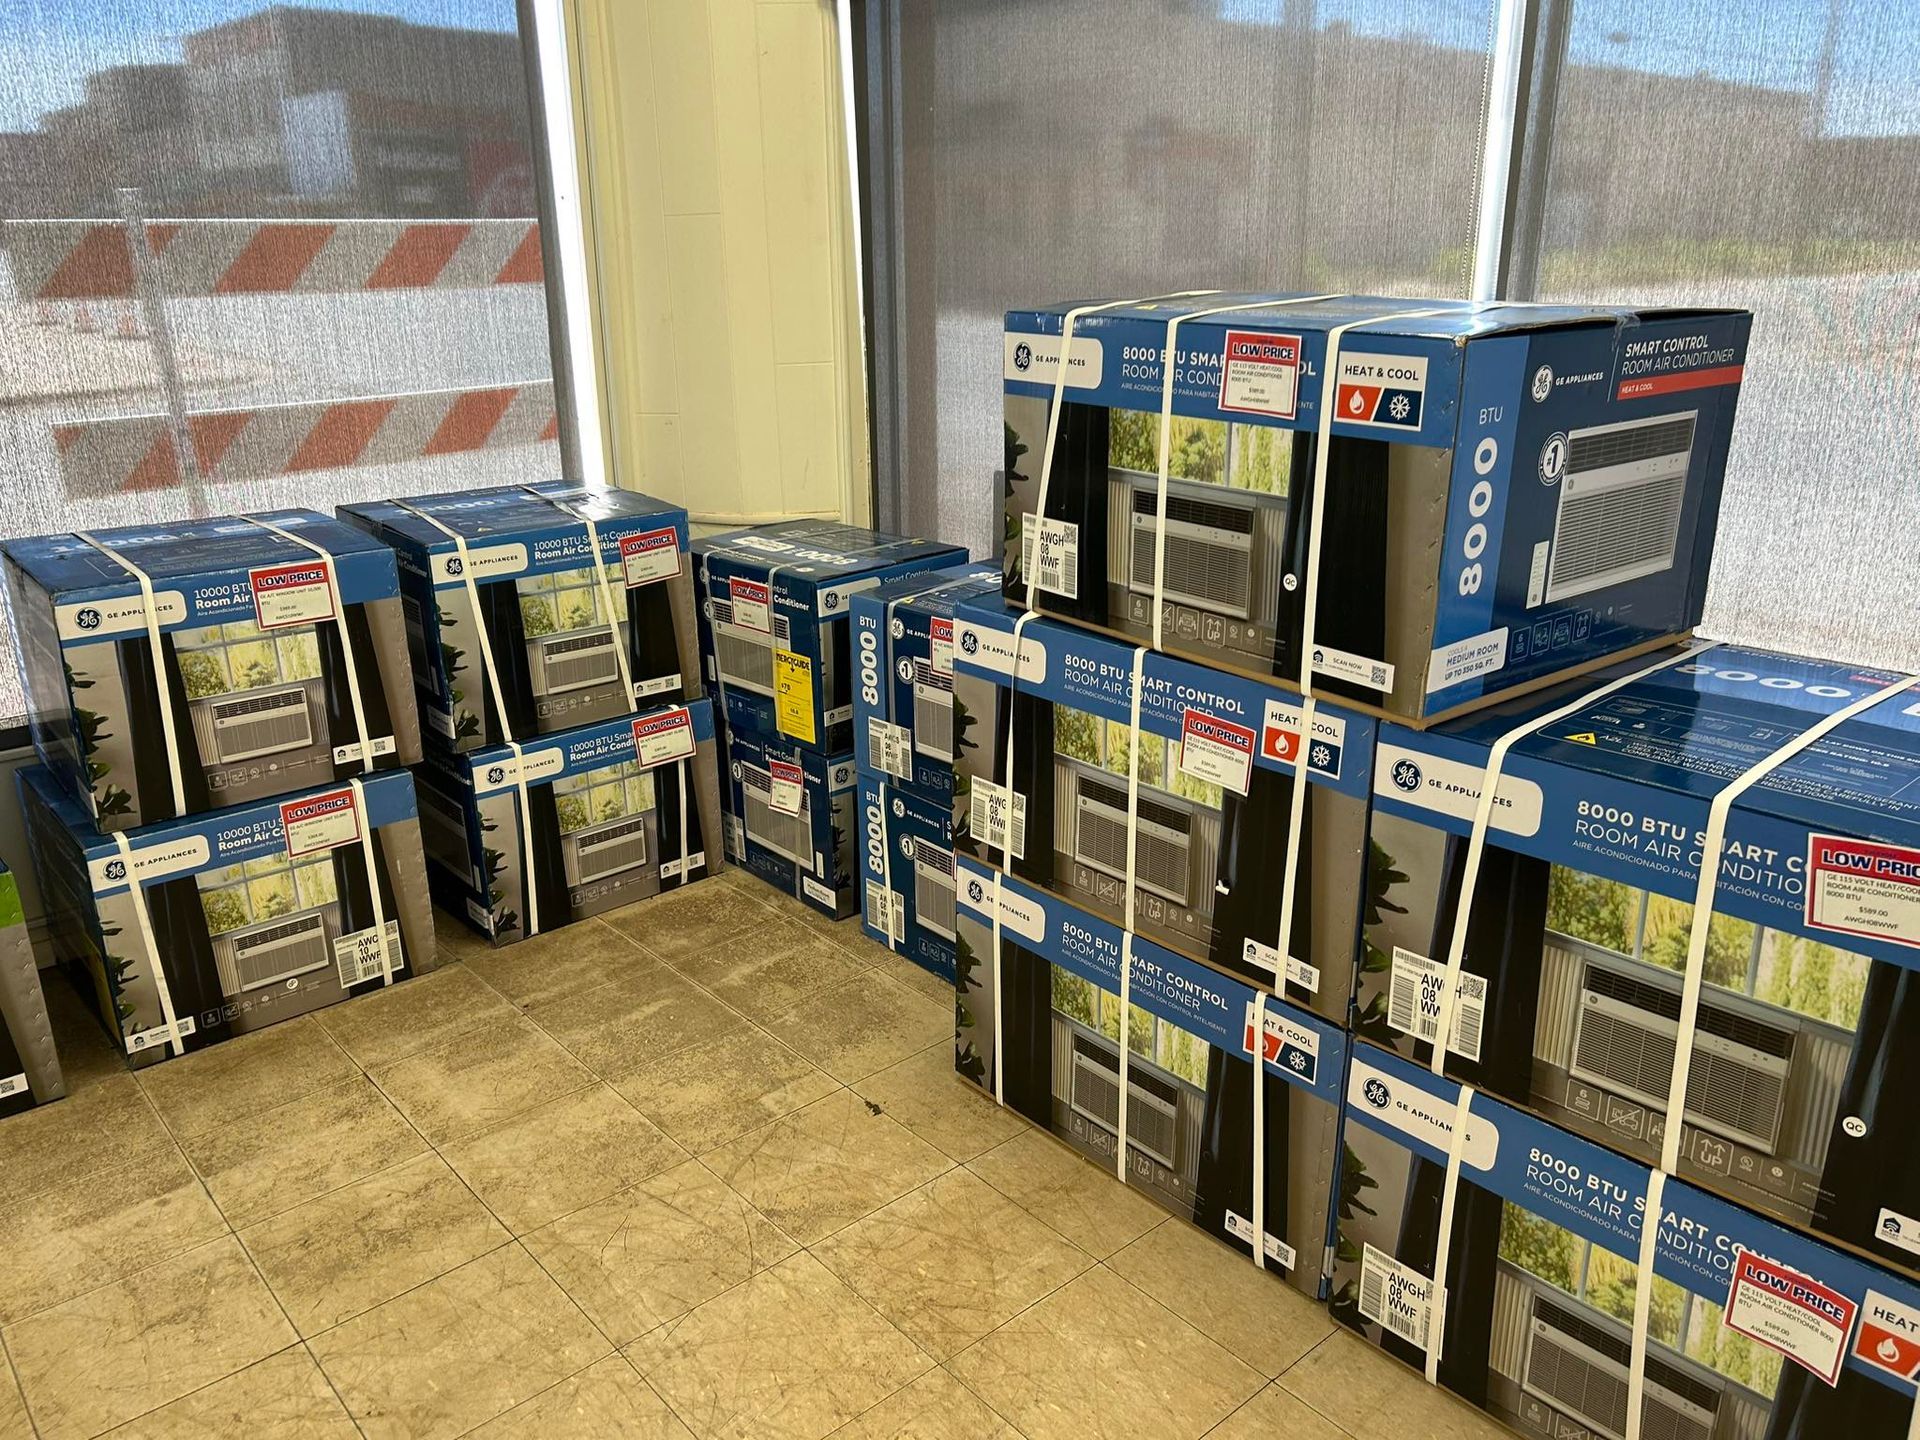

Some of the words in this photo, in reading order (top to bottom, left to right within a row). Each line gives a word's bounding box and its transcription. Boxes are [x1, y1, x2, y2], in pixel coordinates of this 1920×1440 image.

[1123, 346, 1156, 362] 8000
[1233, 343, 1260, 357] LOW
[1262, 346, 1294, 360] PRICE
[1626, 340, 1661, 357] SMART
[1663, 335, 1708, 353] CONTROL
[1035, 355, 1043, 363] GE
[1621, 359, 1652, 375] ROOM
[1654, 357, 1670, 371] AIR
[1673, 348, 1734, 368] CONDITIONER
[1122, 364, 1158, 379] ROOM
[1345, 363, 1373, 378] HEAT
[1377, 366, 1385, 378] &
[1388, 366, 1419, 380] COOL
[1555, 376, 1564, 386] GE
[1565, 372, 1603, 384] APPLIANCES
[1178, 388, 1192, 397] PARA
[1479, 406, 1504, 424] BTU
[1459, 437, 1498, 596] 8000
[534, 538, 561, 551] 10000
[562, 535, 580, 546] BTU
[624, 541, 646, 553] LOW
[647, 534, 672, 547] PRICE
[1040, 530, 1064, 547] AWGH
[535, 548, 561, 559] Room
[562, 545, 576, 555] Air
[1041, 543, 1050, 555] 08
[480, 555, 518, 565] APPLIANCES
[1040, 554, 1059, 569] WWF
[258, 575, 286, 588] LOW
[289, 569, 323, 584] PRICE
[884, 573, 903, 585] Smart
[1285, 577, 1296, 587] QC
[194, 586, 230, 600] 10000
[195, 596, 230, 609] Room
[232, 593, 250, 605] Air
[774, 595, 809, 611] Conditioner
[107, 611, 120, 620] GE
[859, 615, 876, 629] BTU
[1207, 629, 1221, 641] UP
[1576, 626, 1587, 638] UP
[1446, 649, 1475, 666] MEDIUM
[1477, 643, 1499, 656] ROOM
[1739, 651, 1824, 667] APPLIANCES
[860, 631, 879, 706] 8000
[1333, 657, 1348, 666] SCAN
[1348, 662, 1362, 670] NOW
[1064, 669, 1100, 688] ROOM
[1102, 681, 1122, 696] AIR
[1445, 672, 1453, 680] UP
[1454, 669, 1461, 678] TO
[1674, 664, 1852, 698] 8000
[1064, 654, 1096, 672] 8000
[1099, 663, 1124, 679] BTU
[1177, 685, 1245, 715] CONTROL
[1075, 687, 1117, 704] ACONDICIONADO
[638, 723, 658, 735] LOW
[660, 715, 685, 728] PRICE
[1270, 711, 1298, 726] HEAT
[1311, 721, 1338, 738] COOL
[1189, 718, 1215, 735] LOW
[1216, 728, 1249, 749] PRICE
[569, 741, 595, 753] 10000
[596, 735, 613, 746] BTU
[765, 743, 780, 758] Smart
[570, 750, 595, 761] Room
[596, 747, 609, 755] Air
[1621, 748, 1681, 766] COMPLIANCE
[1682, 762, 1708, 772] WITH
[1429, 779, 1442, 789] GE
[1774, 774, 1843, 792] FLAMMABLE
[866, 791, 880, 804] BTU
[1821, 787, 1888, 808] CAREFULLY
[288, 806, 315, 819] LOW
[317, 796, 349, 811] PRICE
[913, 811, 940, 829] APPLIANCES
[1577, 800, 1634, 827] 8000
[1642, 816, 1686, 841] BTU
[217, 825, 251, 840] 10000
[253, 819, 276, 833] BTU
[219, 837, 251, 850] Room
[253, 833, 270, 845] Air
[866, 804, 884, 875] 8000
[1575, 819, 1638, 850] ROOM
[1644, 839, 1680, 862] AIR
[147, 848, 197, 866] APPLIANCES
[1823, 849, 1873, 871] LOW
[1572, 840, 1592, 851] AIRE
[1593, 845, 1670, 873] ACONDICIONADO
[1672, 867, 1697, 881] PARA
[1762, 891, 1785, 907] CON
[1839, 875, 1853, 883] 115
[1854, 877, 1874, 887] VOLT
[1826, 881, 1852, 891] ROOM
[1853, 885, 1866, 894] AIR
[1826, 890, 1845, 899] 8000
[1846, 893, 1861, 901] BTU
[986, 895, 994, 903] GE
[1148, 909, 1162, 920] UP
[1858, 905, 1889, 917] $589.00
[1844, 915, 1899, 930] AWGH08WWF
[359, 946, 369, 956] 10
[1062, 934, 1095, 958] ROOM
[1097, 953, 1116, 969] AIR
[1062, 921, 1092, 943] 8000
[1095, 937, 1118, 956] BTU
[1166, 972, 1229, 1011] CONTROL
[1072, 953, 1110, 977] ACONDICIONADO
[1168, 1000, 1192, 1018] CONTROL
[1193, 1014, 1227, 1035] INTELIGENTE
[1422, 987, 1437, 1002] 08
[1278, 1025, 1284, 1033] &
[1286, 1029, 1313, 1048] COOL
[1579, 1089, 1588, 1098] 6
[1396, 1100, 1409, 1110] GE
[1845, 1121, 1863, 1133] QC
[1700, 1153, 1722, 1166] UP
[1529, 1147, 1580, 1180] 8000
[1586, 1173, 1628, 1202] BTU
[1526, 1163, 1583, 1202] ROOM
[1588, 1196, 1621, 1221] AIR
[1523, 1182, 1541, 1196] AIRE
[1542, 1190, 1612, 1229] ACONDICIONADO
[1613, 1226, 1636, 1240] PARA
[1692, 1263, 1713, 1278] CON
[1388, 1271, 1426, 1301] AWGH
[1389, 1284, 1403, 1299] 08
[1745, 1262, 1790, 1294] LOW
[1792, 1284, 1846, 1324] PRICE
[1388, 1294, 1418, 1319] WWF
[1738, 1299, 1752, 1309] BTU
[1741, 1284, 1750, 1292] GE
[1751, 1287, 1764, 1298] 115
[1765, 1294, 1782, 1306] VOLT
[1783, 1302, 1822, 1326] HEAT/COOL
[1740, 1291, 1761, 1304] ROOM
[1761, 1301, 1773, 1310] AIR
[1774, 1306, 1820, 1335] CONDITIONER
[1873, 1306, 1919, 1333] HEAT
